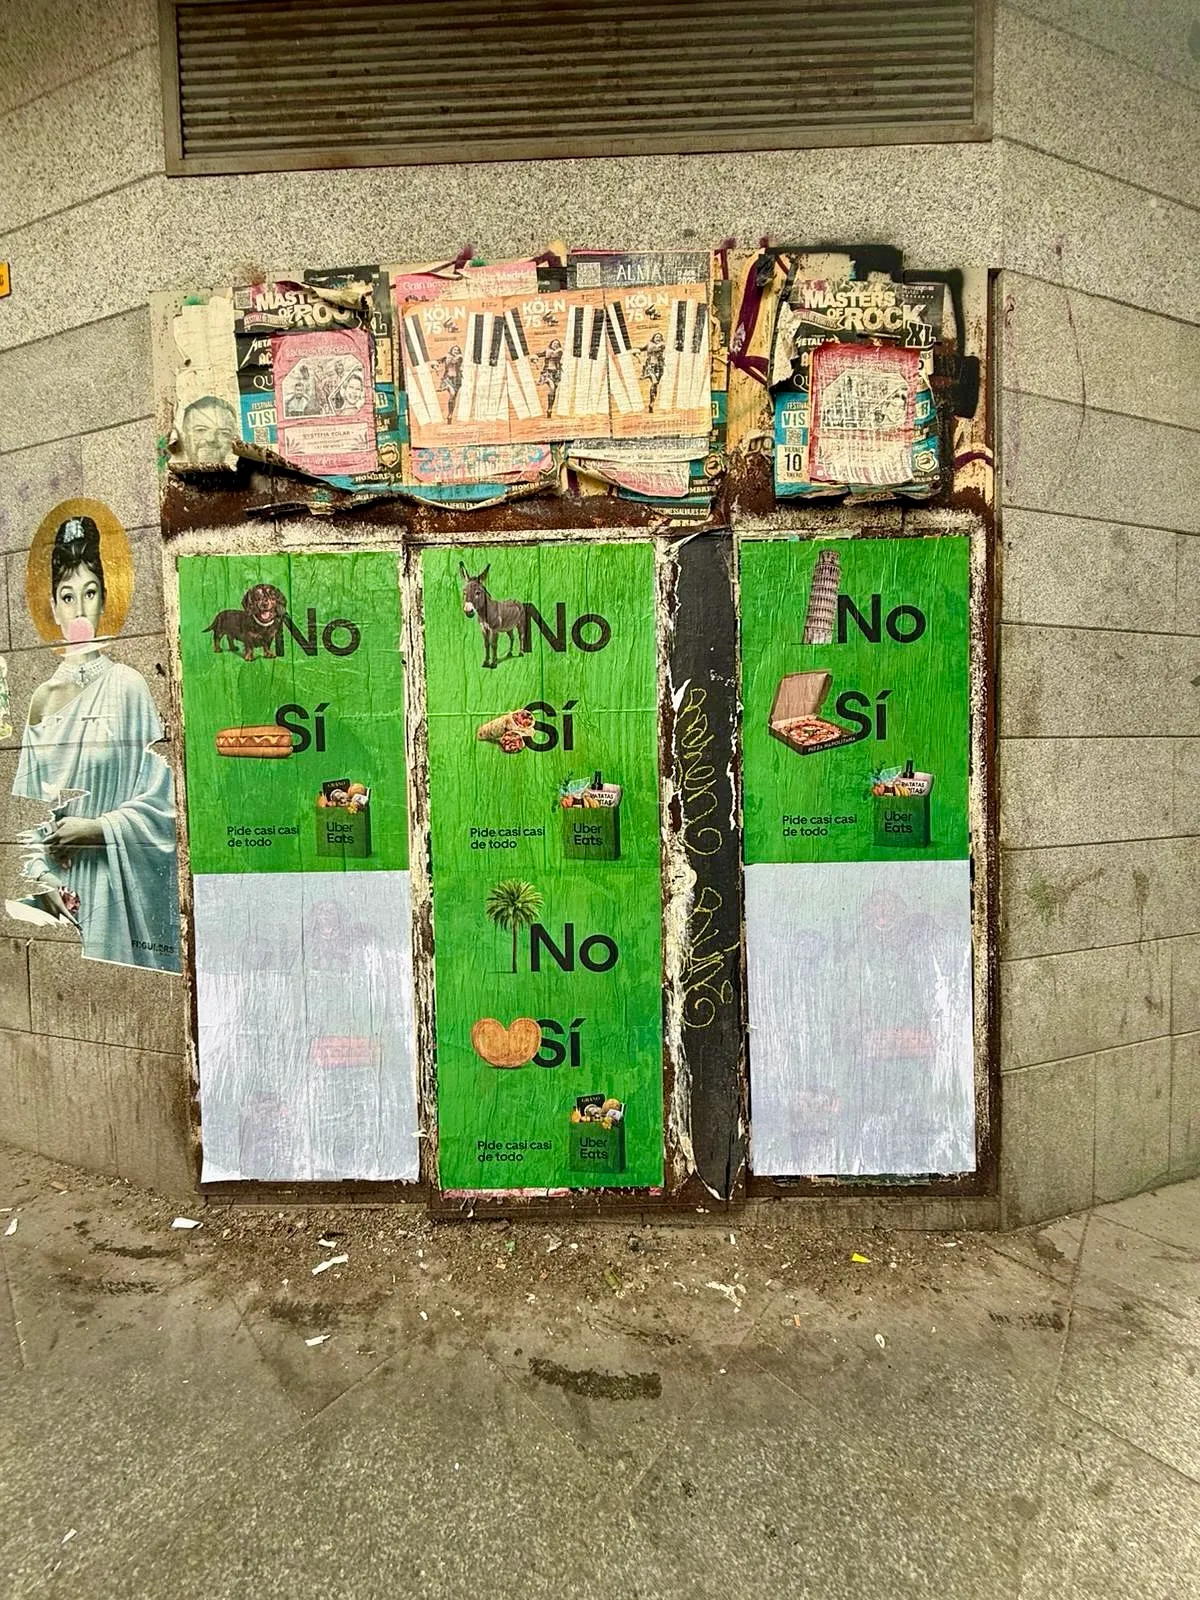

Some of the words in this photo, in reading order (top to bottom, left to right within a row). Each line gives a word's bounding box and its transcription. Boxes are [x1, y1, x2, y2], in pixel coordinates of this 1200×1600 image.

[616, 262, 662, 281] ALMA
[522, 297, 566, 316] KÖLN
[625, 291, 669, 309] KÖLN
[803, 291, 896, 309] MASTERS
[278, 307, 293, 319] OF
[293, 303, 351, 330] ROC
[422, 303, 466, 322] KÖLN
[626, 308, 645, 322] 75
[826, 308, 845, 319] OF
[844, 304, 927, 331] ROCK
[424, 321, 443, 334] 75
[523, 315, 543, 328] 75
[904, 320, 937, 349] XL
[783, 412, 806, 426] VIS
[784, 453, 802, 472] 10
[837, 594, 927, 644] No
[275, 607, 361, 658] No
[522, 602, 612, 653] No
[835, 689, 892, 741] Sí
[275, 702, 331, 753] Sí
[523, 701, 579, 752] Sí
[782, 815, 808, 825] Pide
[810, 814, 833, 824] casi
[834, 814, 857, 824] casi
[884, 811, 912, 822] Uber
[227, 826, 252, 836] Pide
[254, 825, 276, 836] casi
[278, 825, 300, 835] casi
[326, 822, 354, 833] Uber
[470, 828, 496, 838] Pide
[498, 827, 521, 837] casi
[523, 826, 545, 837] casi
[573, 823, 602, 834] Uber
[783, 827, 798, 837] de
[800, 826, 828, 837] todo
[885, 822, 913, 833] Eats
[227, 838, 243, 848] de
[245, 837, 273, 848] todo
[327, 833, 354, 844] Eats
[470, 840, 487, 850] de
[489, 839, 518, 849] todo
[574, 835, 603, 846] Eats
[530, 922, 619, 973] No
[531, 1018, 587, 1068] Sí
[477, 1141, 503, 1151] Pide
[505, 1140, 528, 1150] casi
[529, 1140, 552, 1150] casi
[579, 1137, 607, 1148] Uber
[478, 1153, 493, 1163] de
[496, 1152, 524, 1162] todo
[580, 1149, 609, 1160] Eats
